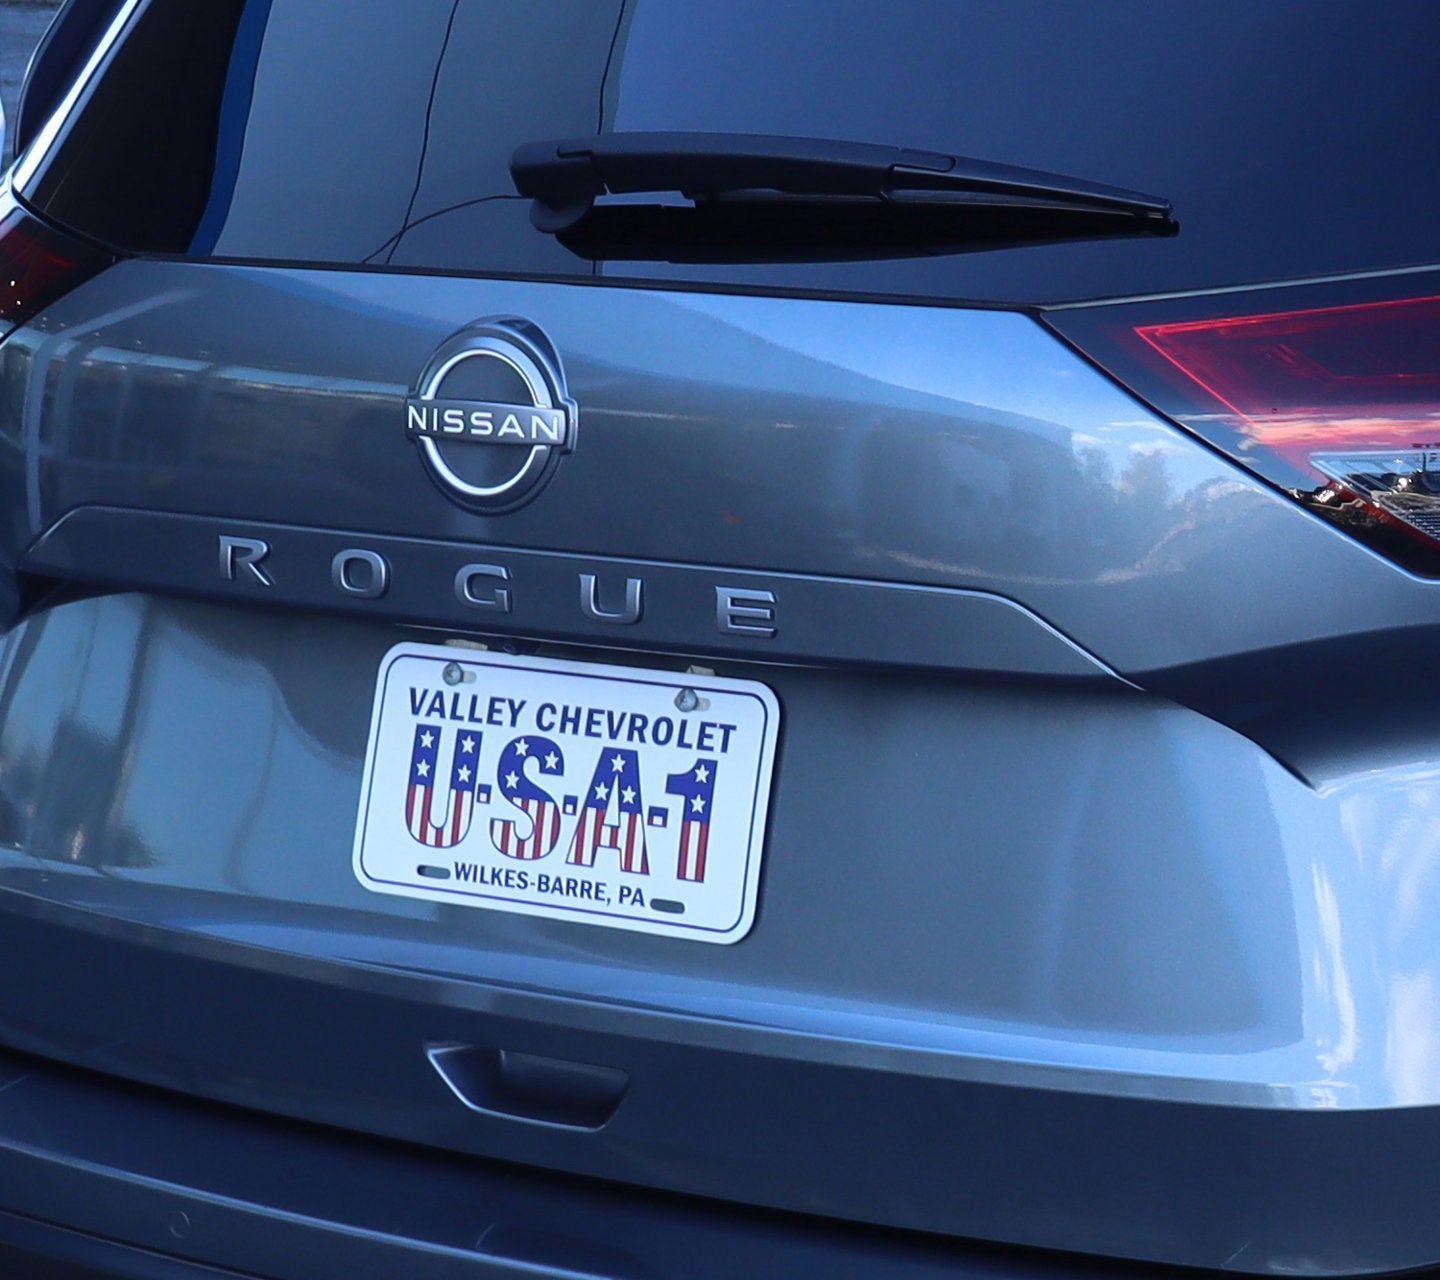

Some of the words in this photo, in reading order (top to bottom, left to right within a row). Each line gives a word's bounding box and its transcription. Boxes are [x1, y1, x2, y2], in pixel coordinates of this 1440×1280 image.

[407, 405, 560, 441] NISSAN
[218, 534, 778, 638] ROGUE
[409, 686, 527, 728] VALLEY
[535, 702, 737, 754] CHEVROLET
[454, 861, 612, 907] WILKES-BARRE,
[618, 884, 646, 908] PA
